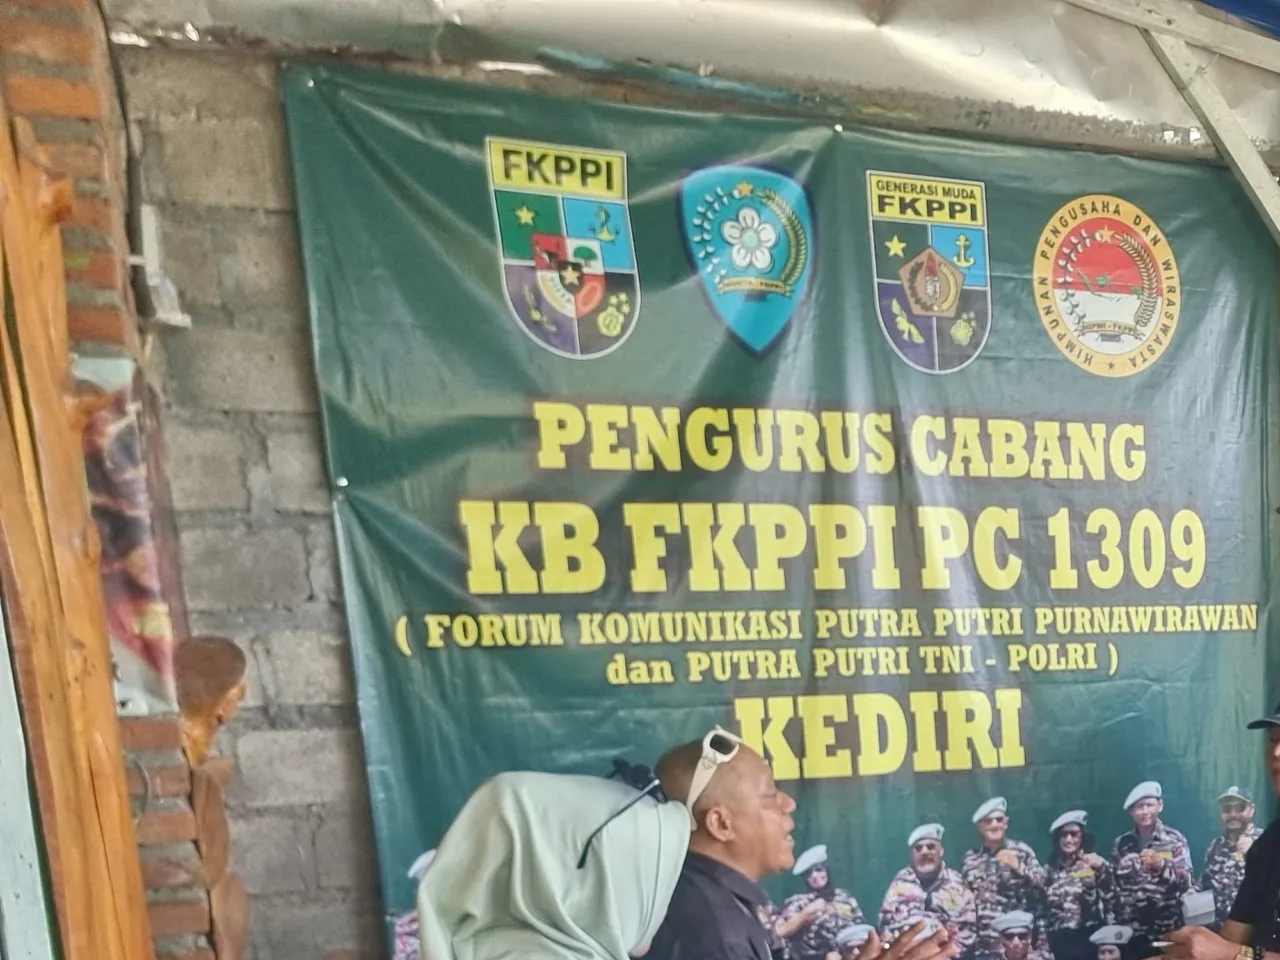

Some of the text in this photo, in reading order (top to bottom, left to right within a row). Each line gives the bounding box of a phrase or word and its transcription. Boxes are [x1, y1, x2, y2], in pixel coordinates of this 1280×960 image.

[501, 149, 614, 191] FKPPI
[876, 180, 977, 200] GENERASI MUDA
[877, 194, 978, 222] FKPPI
[1039, 201, 1176, 368] HIMPUNAN PENGUSAHA DAN WIRASWASTA
[534, 401, 1147, 481] PENGURUS CABANG
[458, 500, 1207, 595] KB FKPPI PC 1309
[425, 613, 564, 648] FORUM
[578, 610, 802, 644] KOMUNIKASI
[815, 608, 922, 638] PUTRA
[933, 607, 1024, 635] PUTRI
[1034, 603, 1258, 634] PURNAWIRAWAN
[606, 653, 674, 685] dan
[687, 649, 802, 682] PUTRA
[812, 646, 911, 677] PUTRI
[919, 645, 974, 674] TNI
[1007, 643, 1098, 671] POLRI
[733, 688, 1028, 781] KEDIRI
